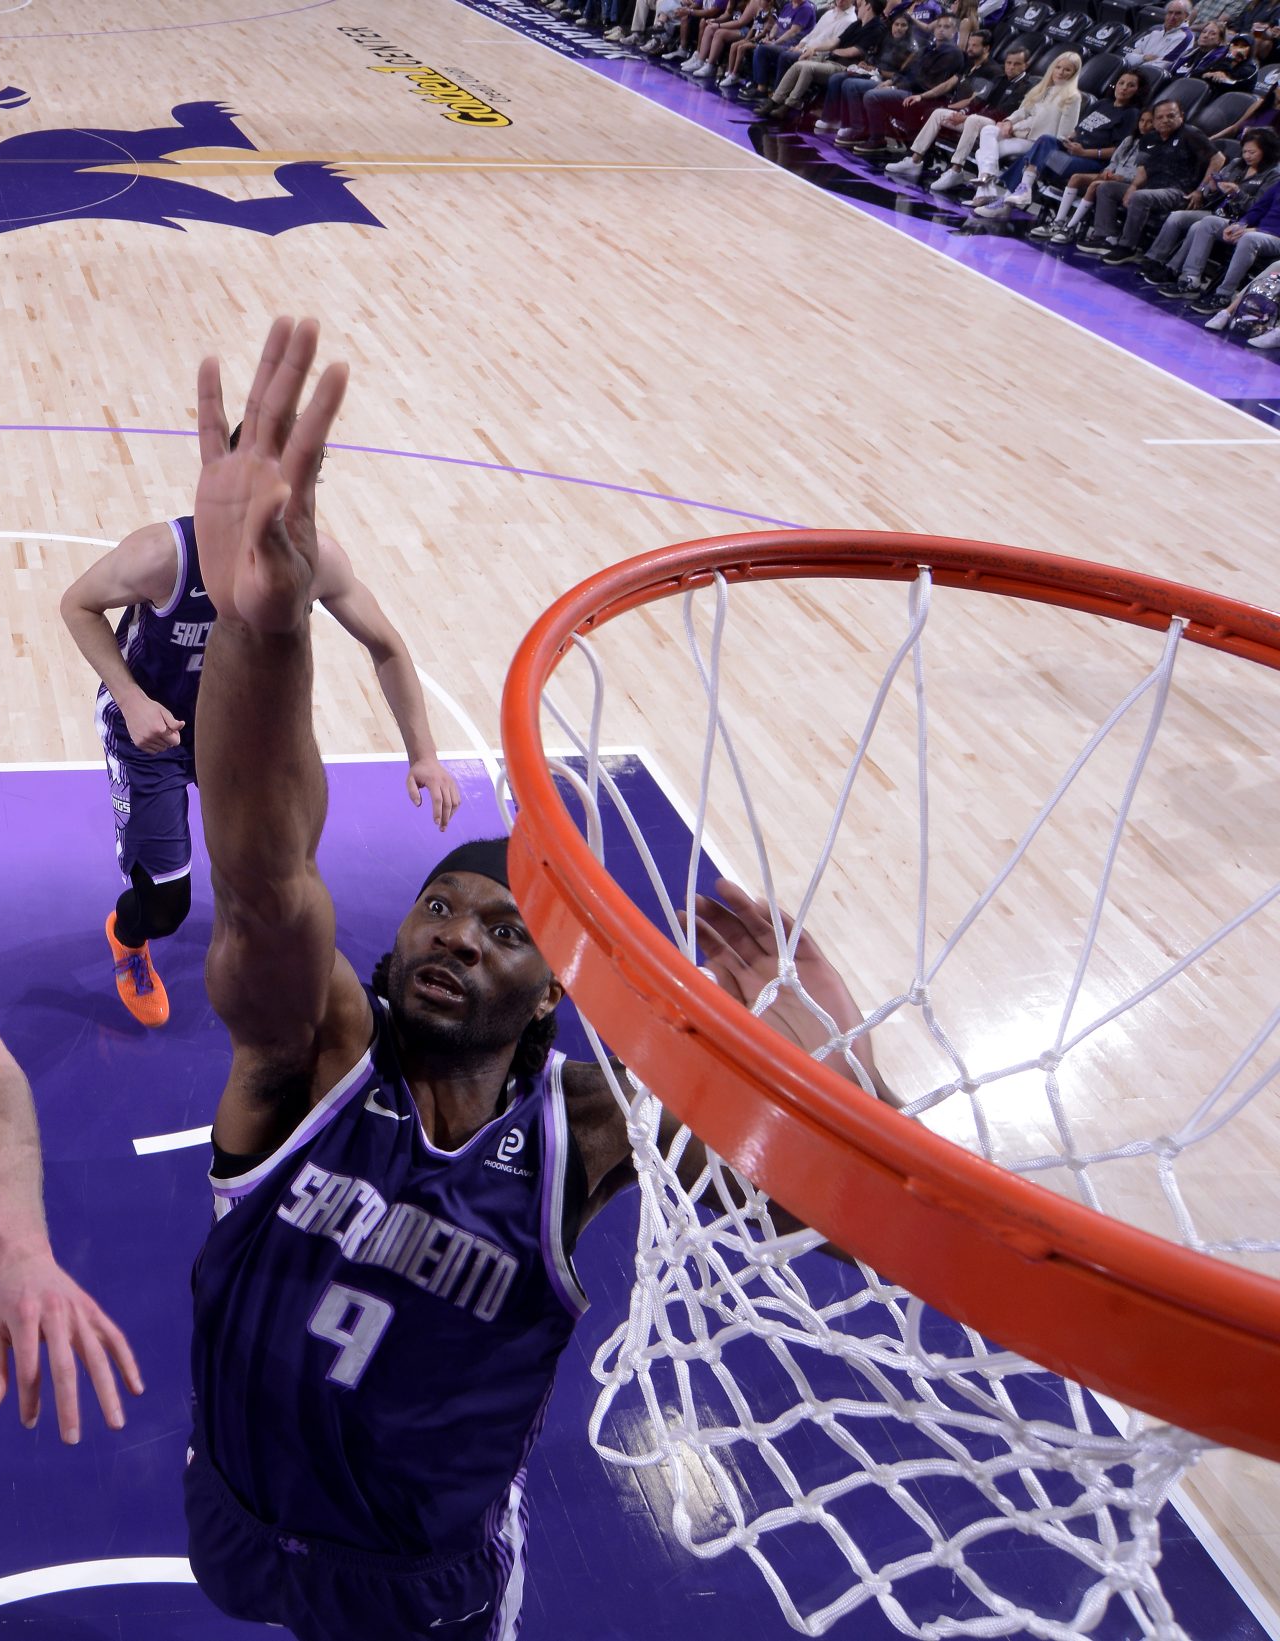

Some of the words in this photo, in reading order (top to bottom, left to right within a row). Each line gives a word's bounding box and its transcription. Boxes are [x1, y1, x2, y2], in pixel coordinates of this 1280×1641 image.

[336, 26, 423, 65] CENTER
[483, 1159, 513, 1173] PHOONG
[276, 1160, 520, 1323] SACRAMENTO
[307, 1280, 396, 1391] 9
